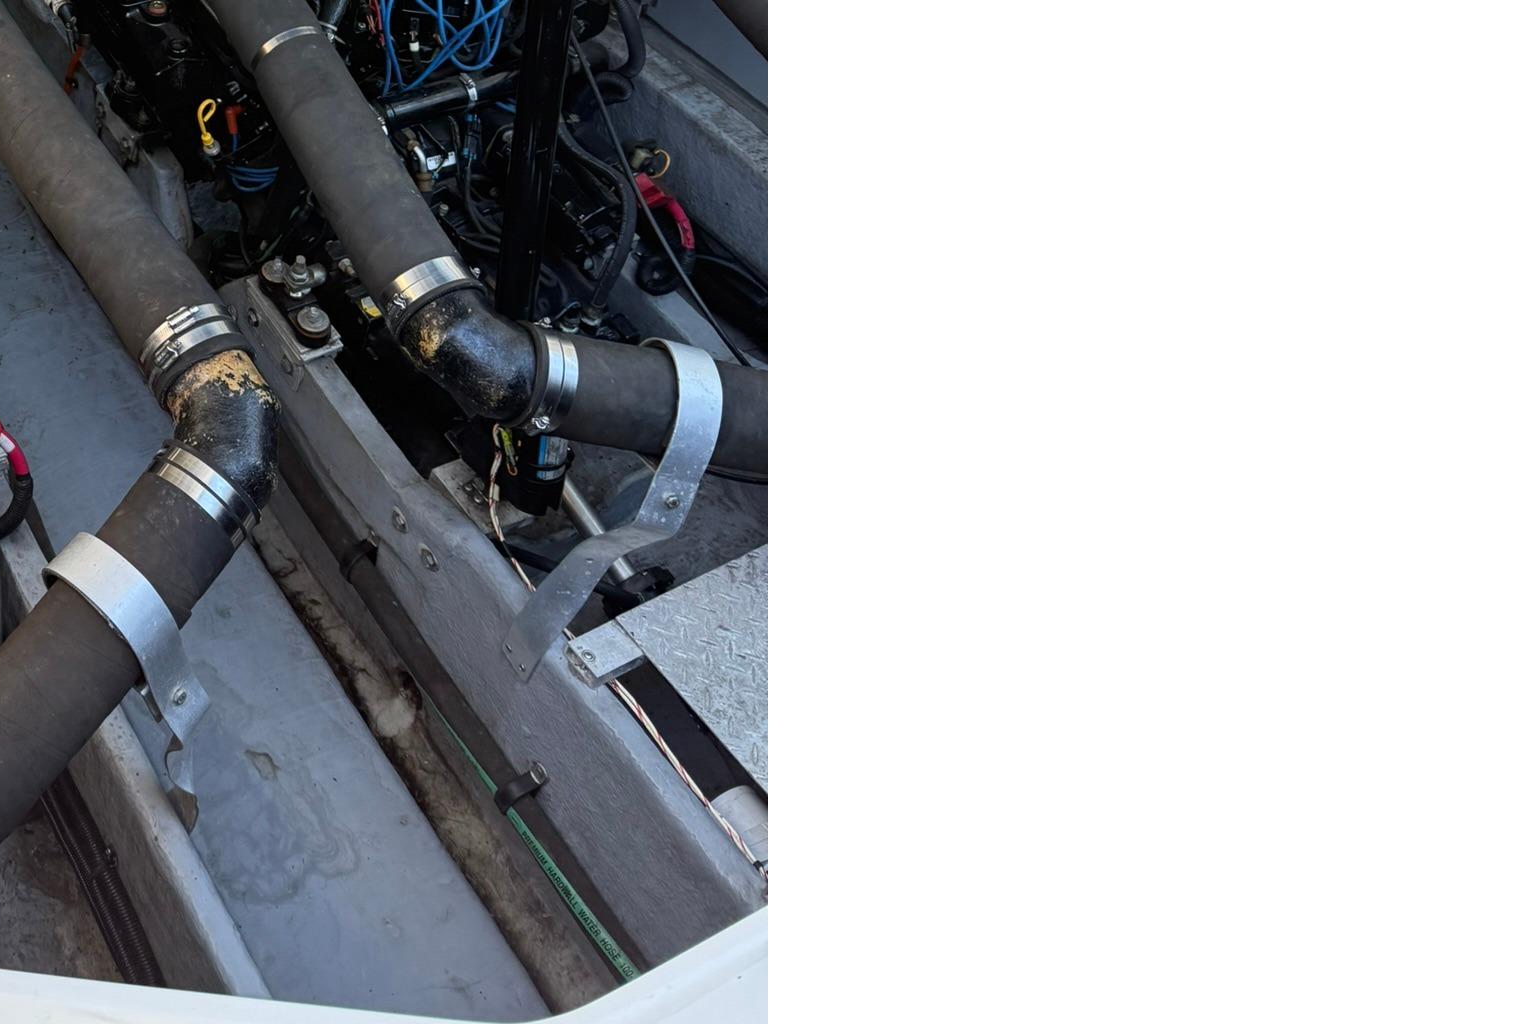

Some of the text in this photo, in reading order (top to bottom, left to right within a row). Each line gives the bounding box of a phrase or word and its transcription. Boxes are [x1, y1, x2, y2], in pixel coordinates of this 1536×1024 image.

[521, 830, 548, 866] PREMIUM
[546, 866, 579, 910] HARDWALL
[577, 908, 601, 938] WATER
[599, 938, 621, 962] HOSE
